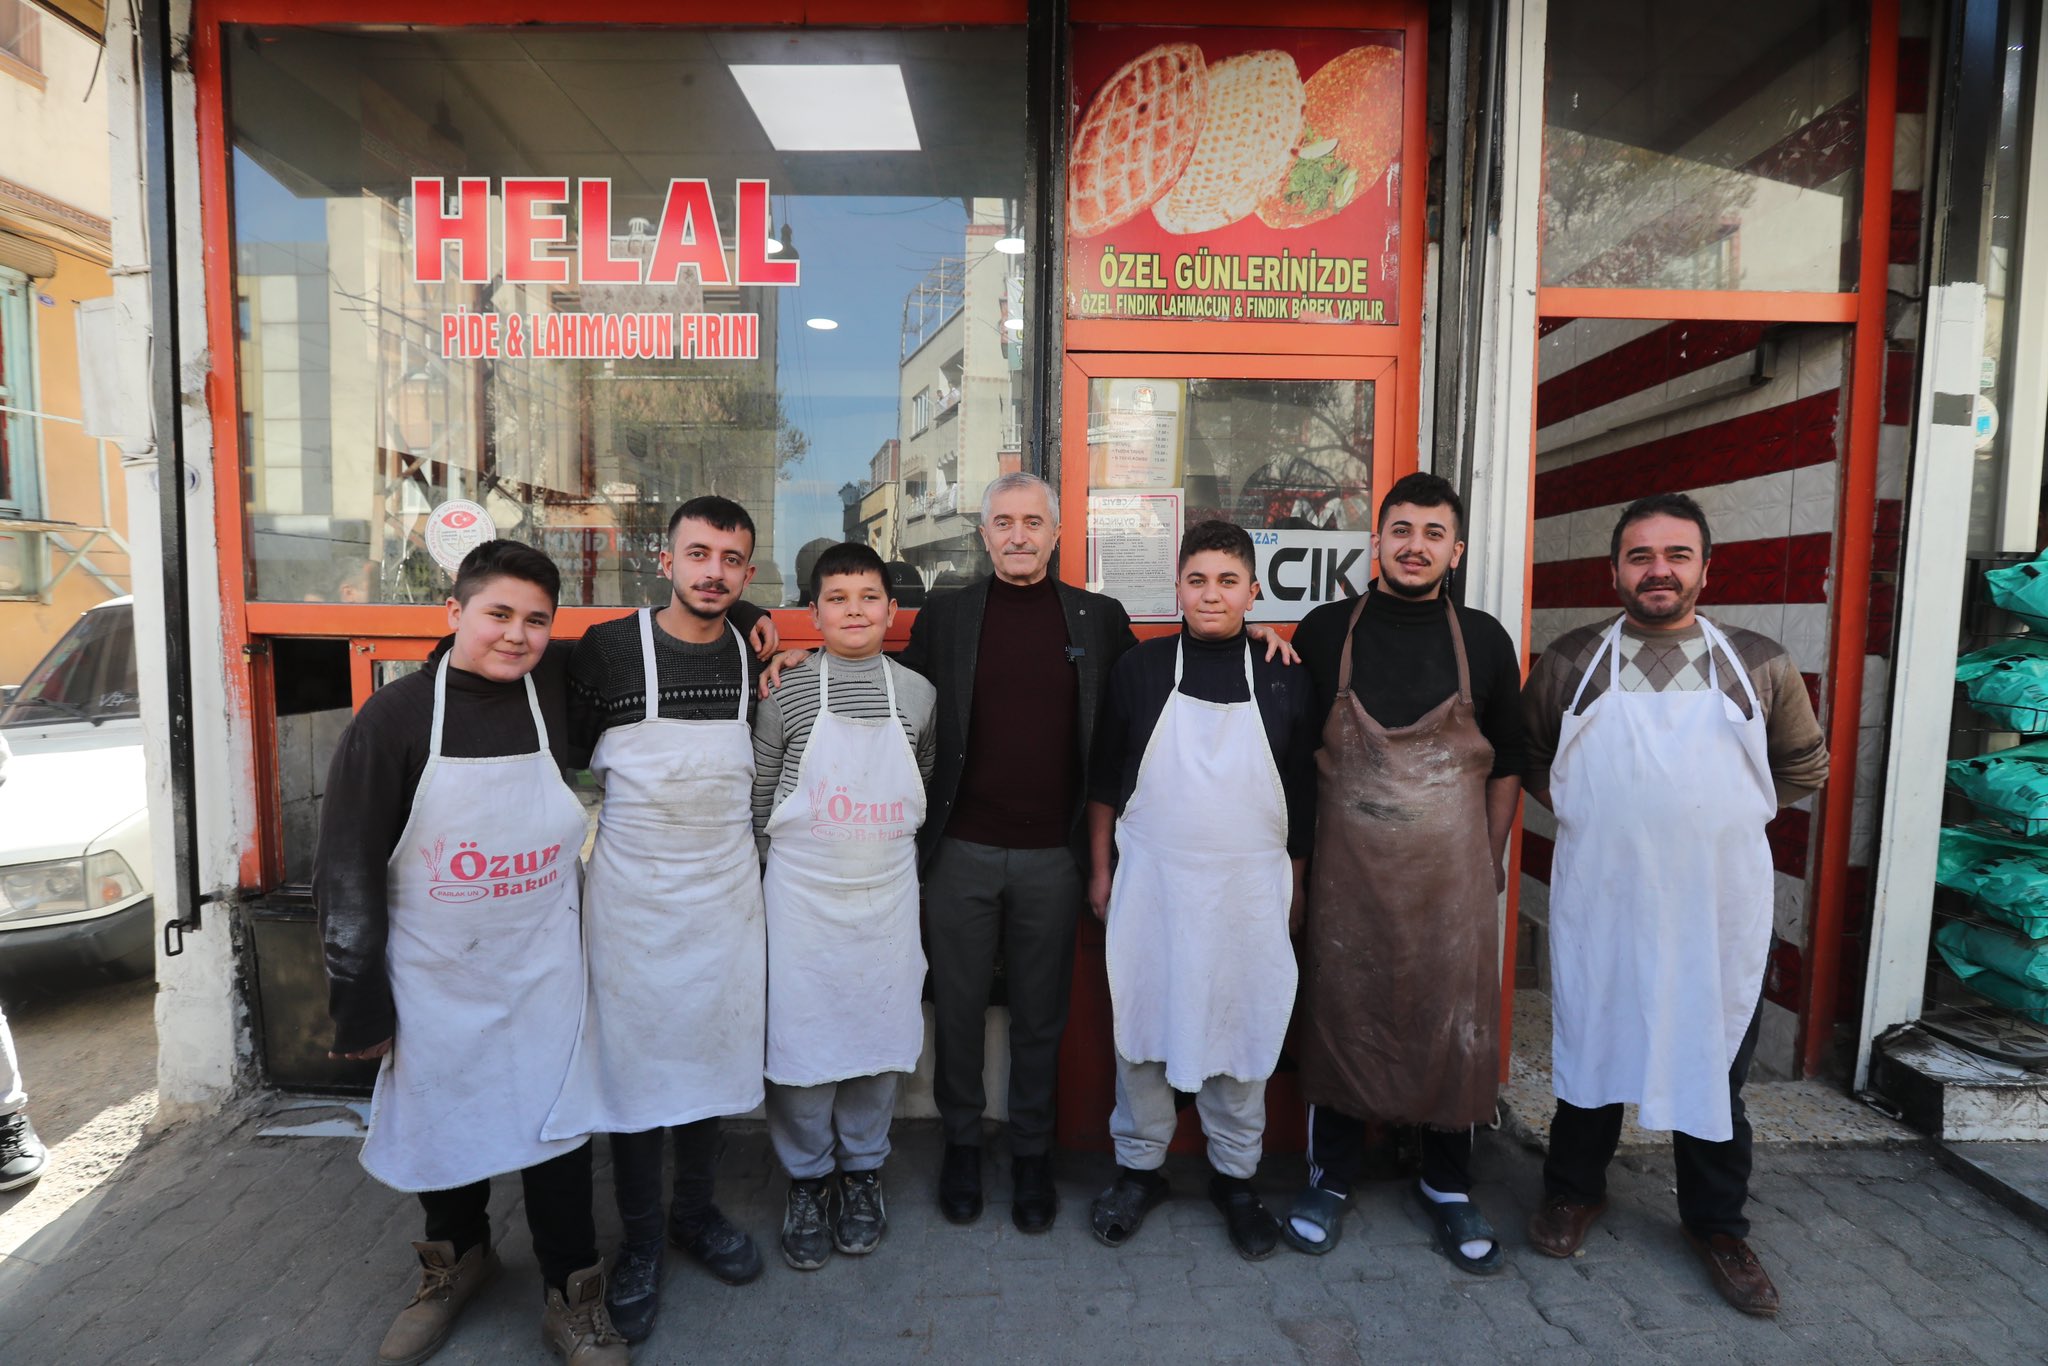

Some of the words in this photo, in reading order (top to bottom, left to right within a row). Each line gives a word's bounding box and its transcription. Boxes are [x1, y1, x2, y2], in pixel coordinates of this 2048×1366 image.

[411, 176, 800, 286] HELAL
[1099, 246, 1167, 289] ÖZEL
[1174, 247, 1368, 294] GÜNLERİNİZDE
[1080, 290, 1112, 314] ÖZEL
[1116, 295, 1158, 316] FINDIK
[1161, 295, 1230, 317] LAHMACUN
[1233, 299, 1243, 317] &
[1246, 298, 1288, 319] FINDIK
[1337, 299, 1384, 321] YAPILIR
[441, 304, 500, 359] PİDE
[505, 312, 526, 359] &
[530, 312, 673, 359] LAHMACUN
[679, 312, 760, 360] FIRINI
[1254, 547, 1365, 602] CIK
[827, 785, 905, 823] Özun
[450, 841, 561, 880] Özun
[492, 869, 557, 898] Bakun
